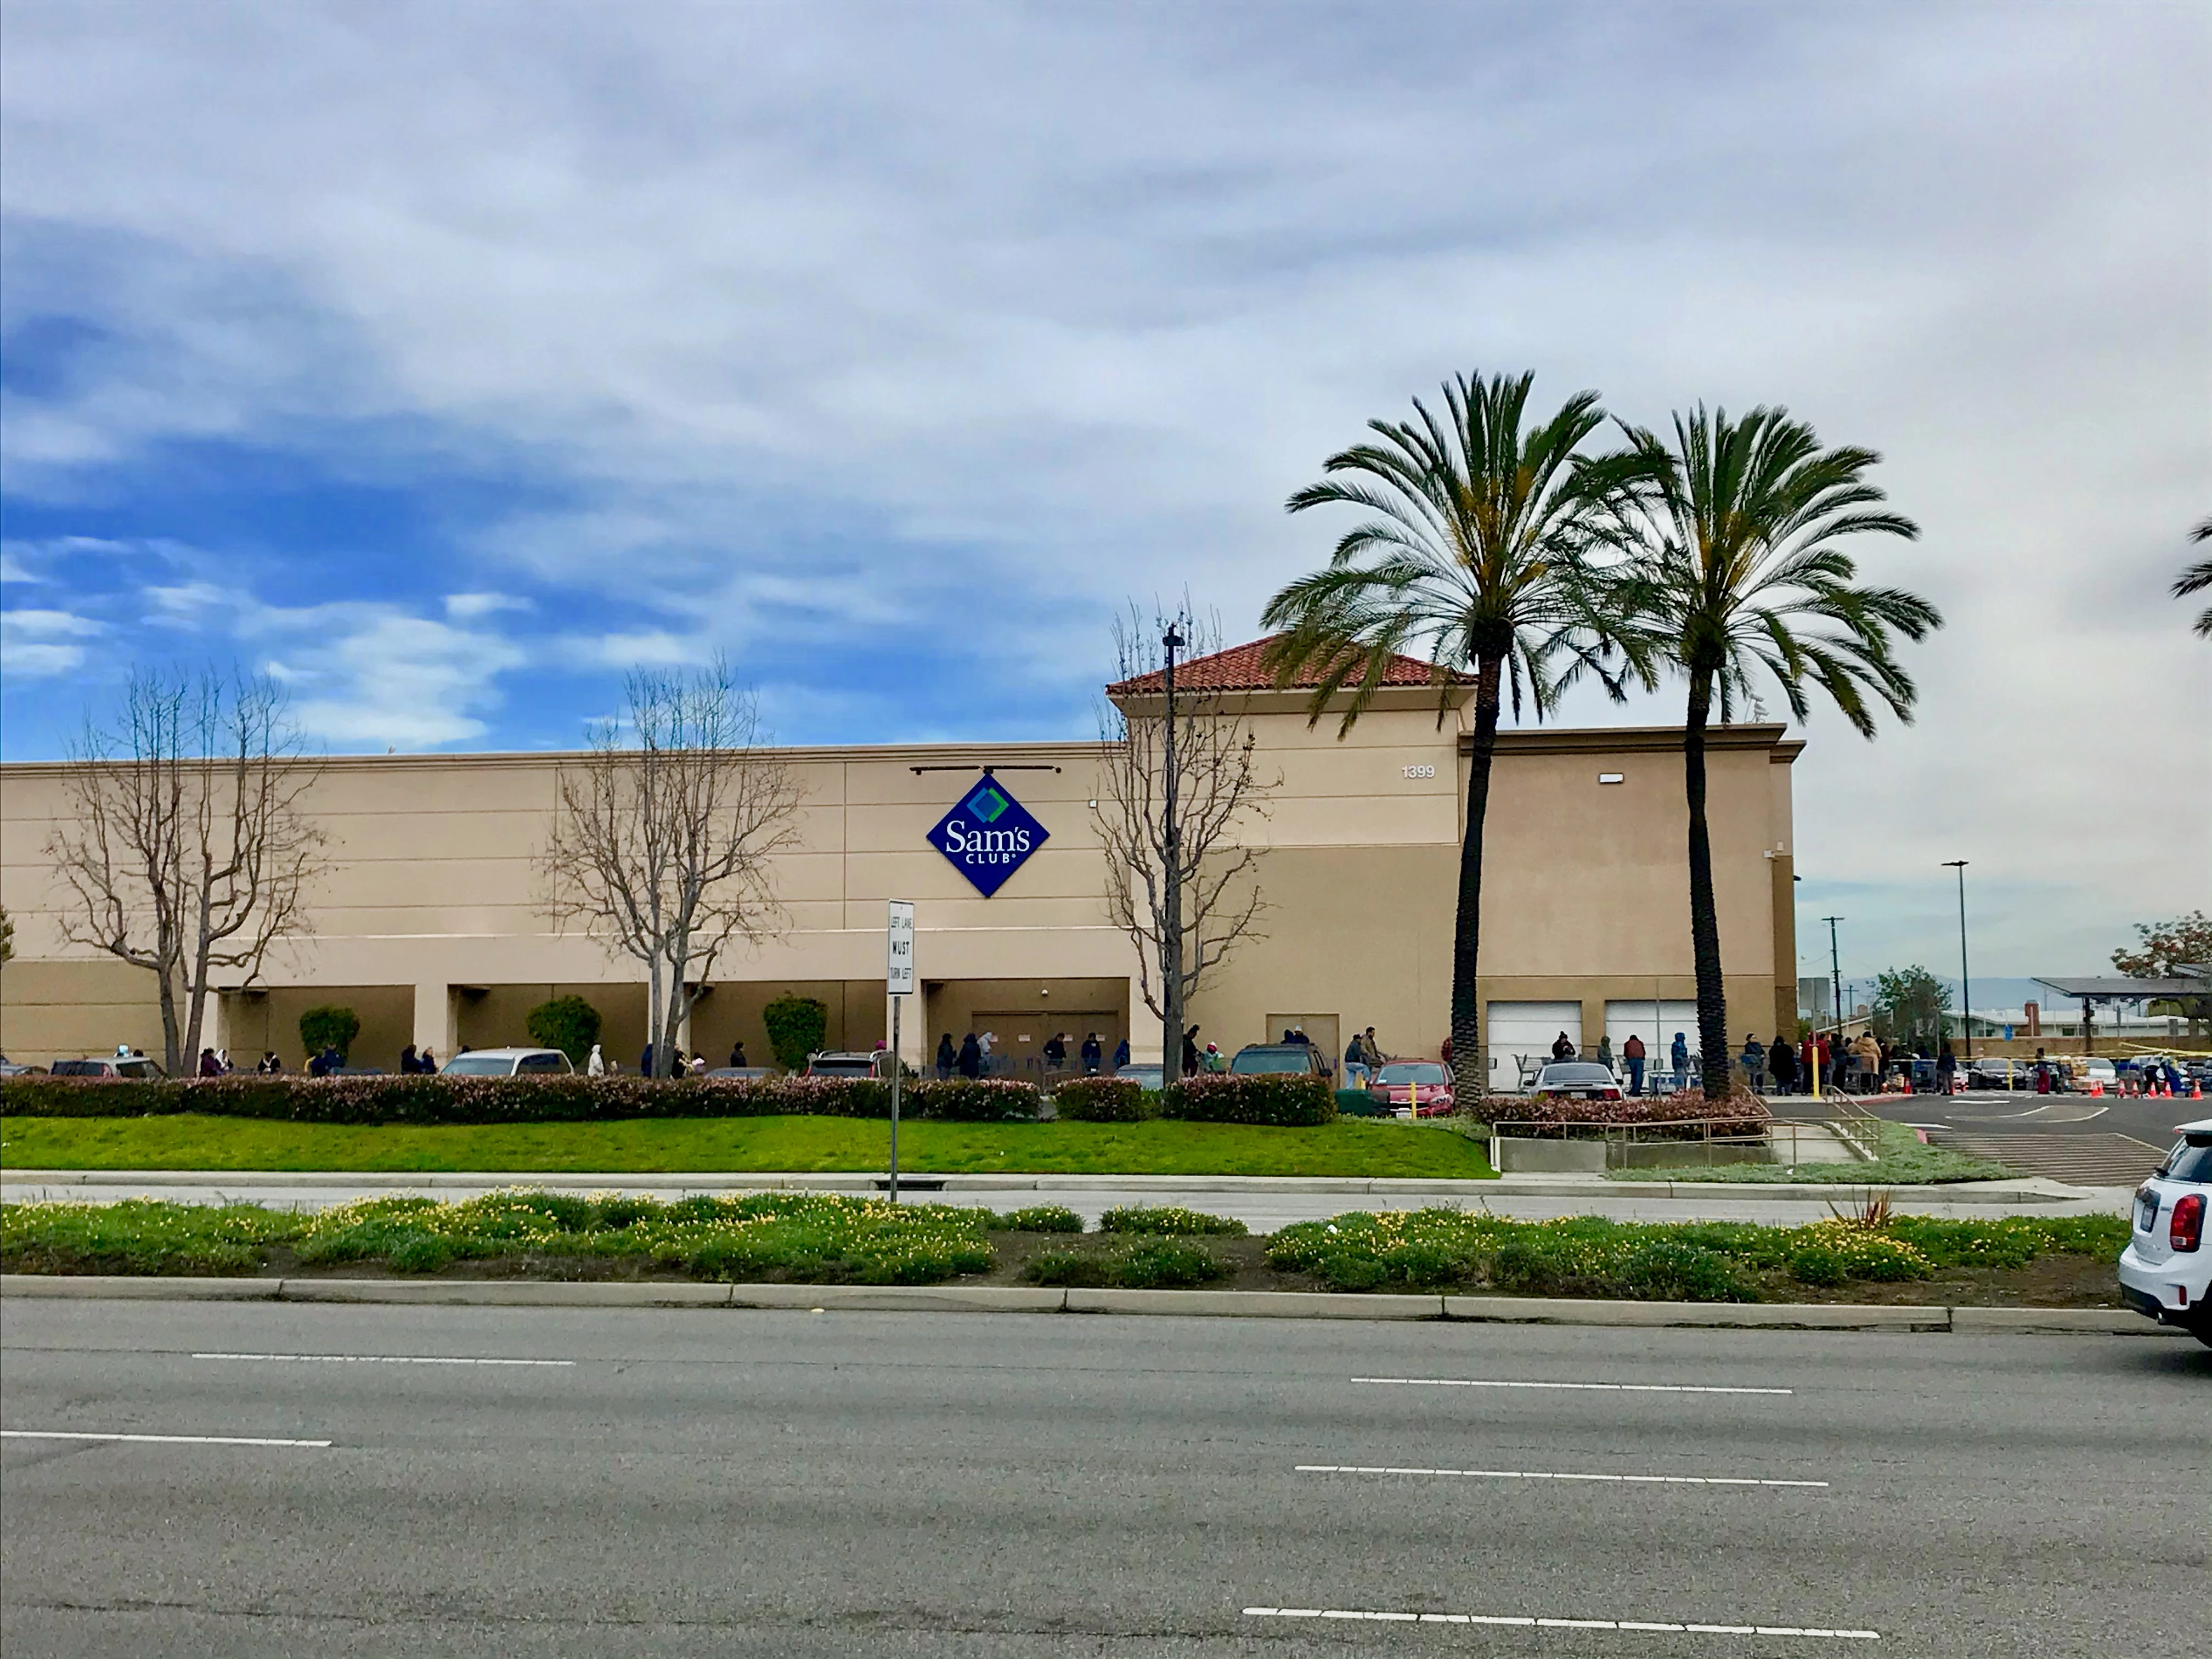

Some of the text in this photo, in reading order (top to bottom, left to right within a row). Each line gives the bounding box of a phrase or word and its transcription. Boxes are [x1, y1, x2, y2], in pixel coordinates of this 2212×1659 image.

[1401, 765, 1435, 778] 1399
[946, 820, 1030, 852] Sam's
[966, 853, 1010, 864] CLUB
[890, 916, 912, 929] LEFT LANE
[892, 941, 910, 956] MUST
[890, 967, 912, 979] TURN LEFT
